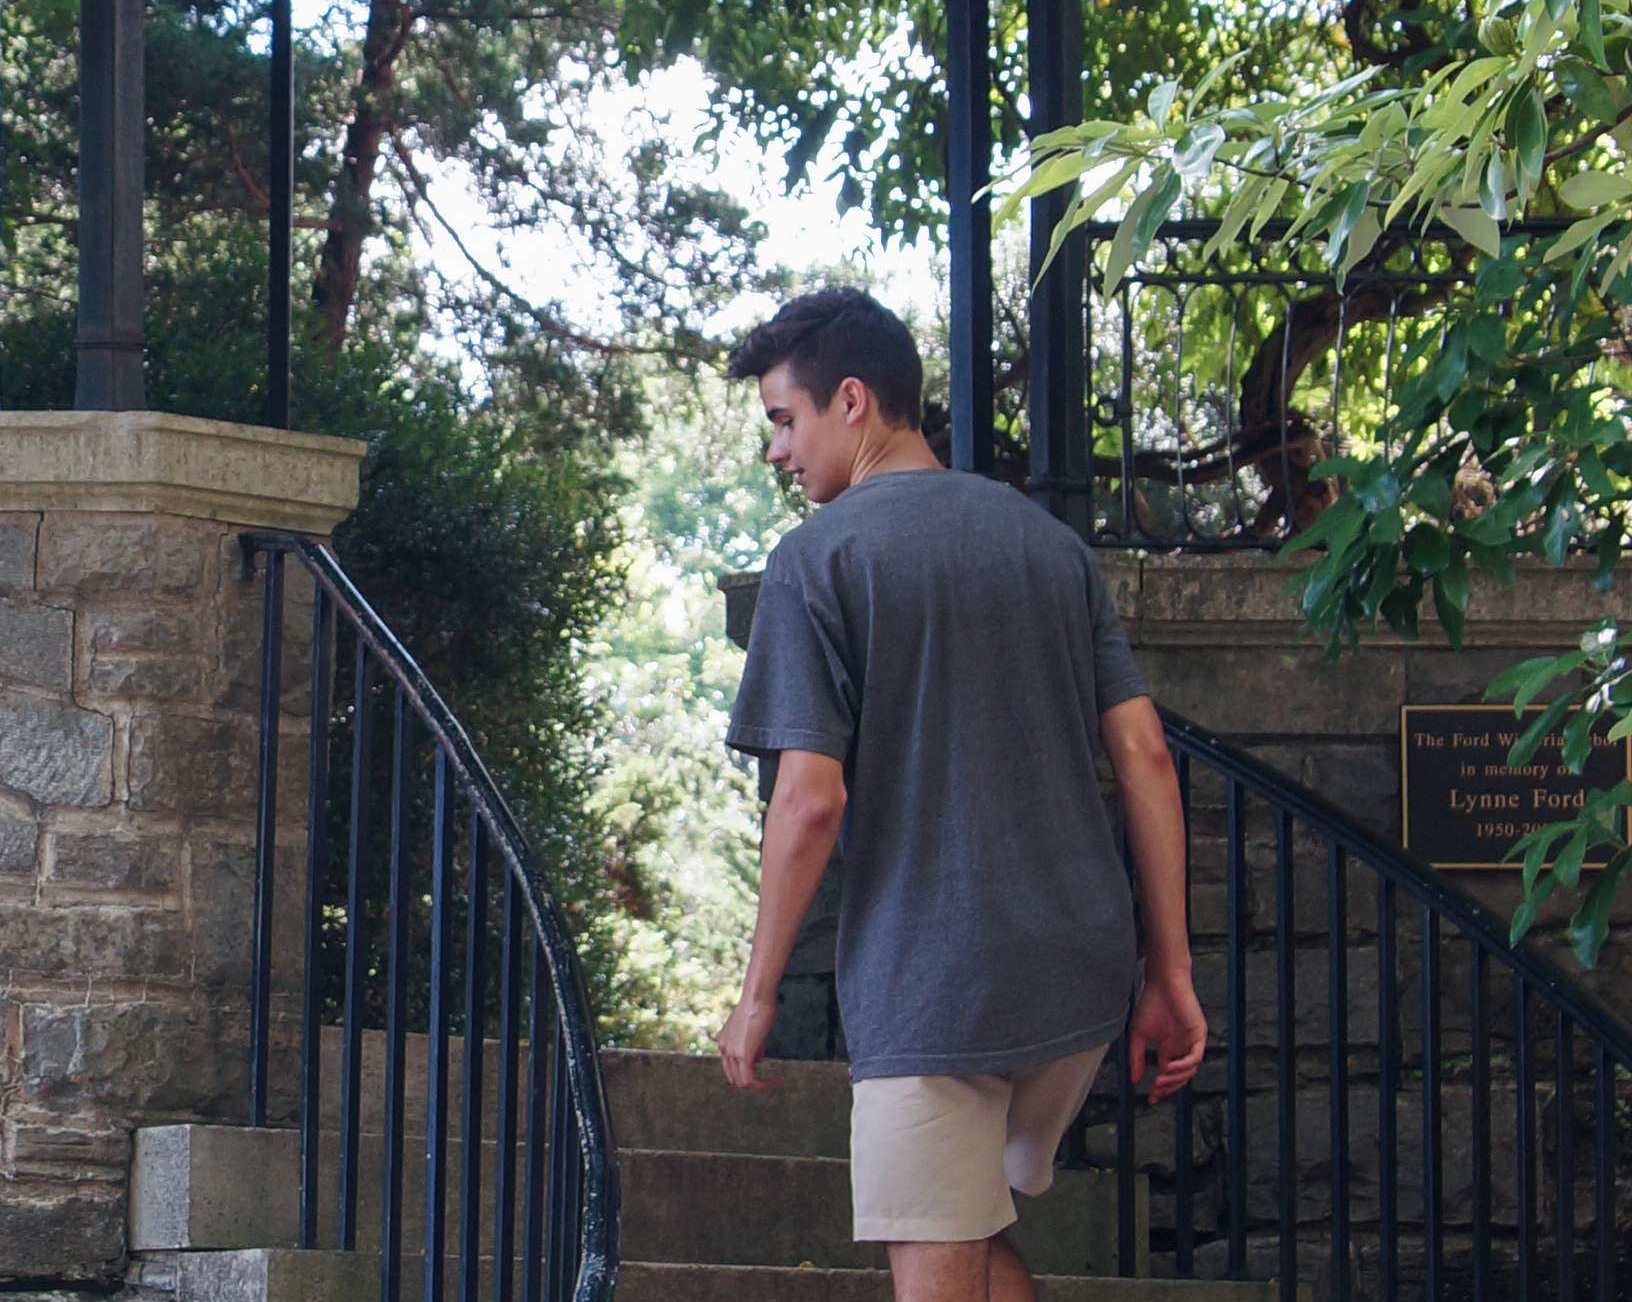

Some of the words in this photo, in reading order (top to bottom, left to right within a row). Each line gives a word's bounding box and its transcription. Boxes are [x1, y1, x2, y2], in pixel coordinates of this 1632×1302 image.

[1414, 732, 1445, 747] The
[1452, 732, 1490, 747] Ford
[1498, 732, 1564, 747] Wiria
[1460, 761, 1477, 776] in
[1449, 789, 1520, 813] Lynne
[1533, 789, 1585, 808] Ford
[1476, 822, 1550, 837] 1950-20
